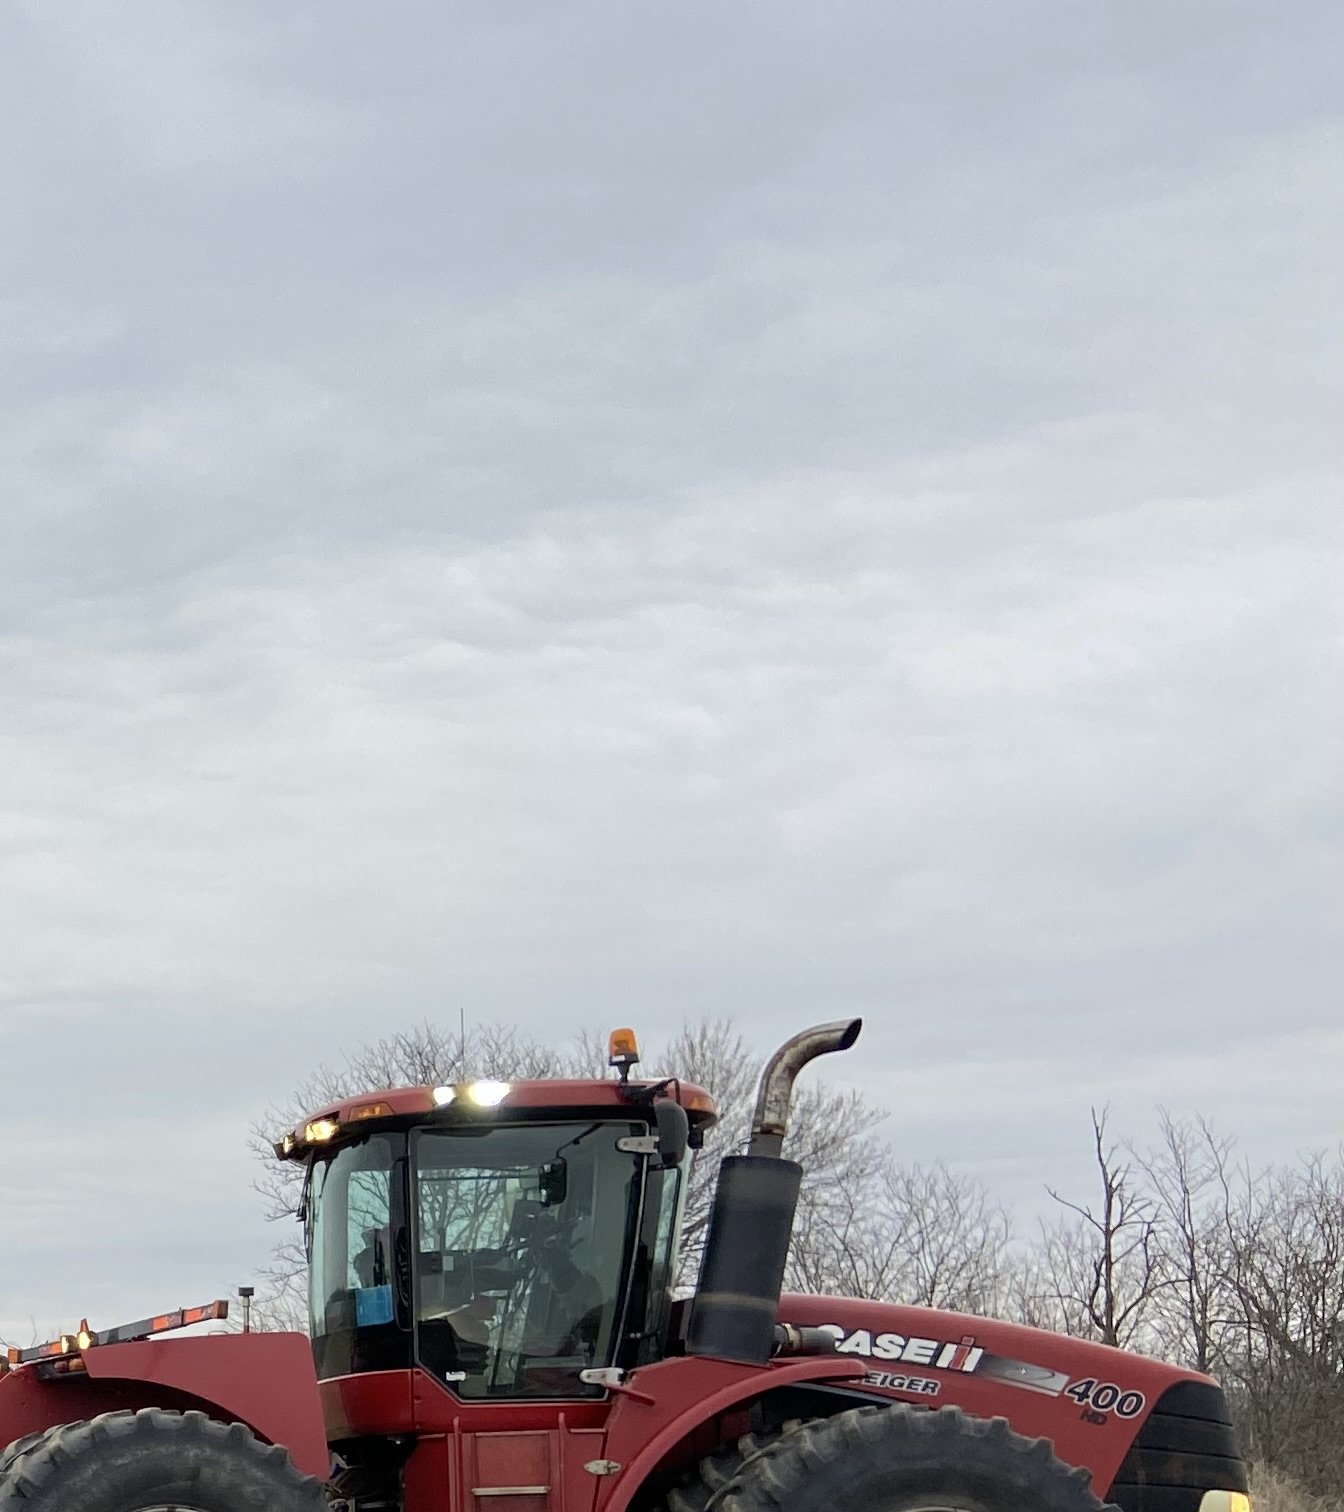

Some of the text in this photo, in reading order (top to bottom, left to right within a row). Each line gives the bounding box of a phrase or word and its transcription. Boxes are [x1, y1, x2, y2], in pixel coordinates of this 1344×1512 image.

[862, 1370, 941, 1396] EIGER
[1065, 1378, 1146, 1418] 400
[1080, 1409, 1108, 1426] HD
